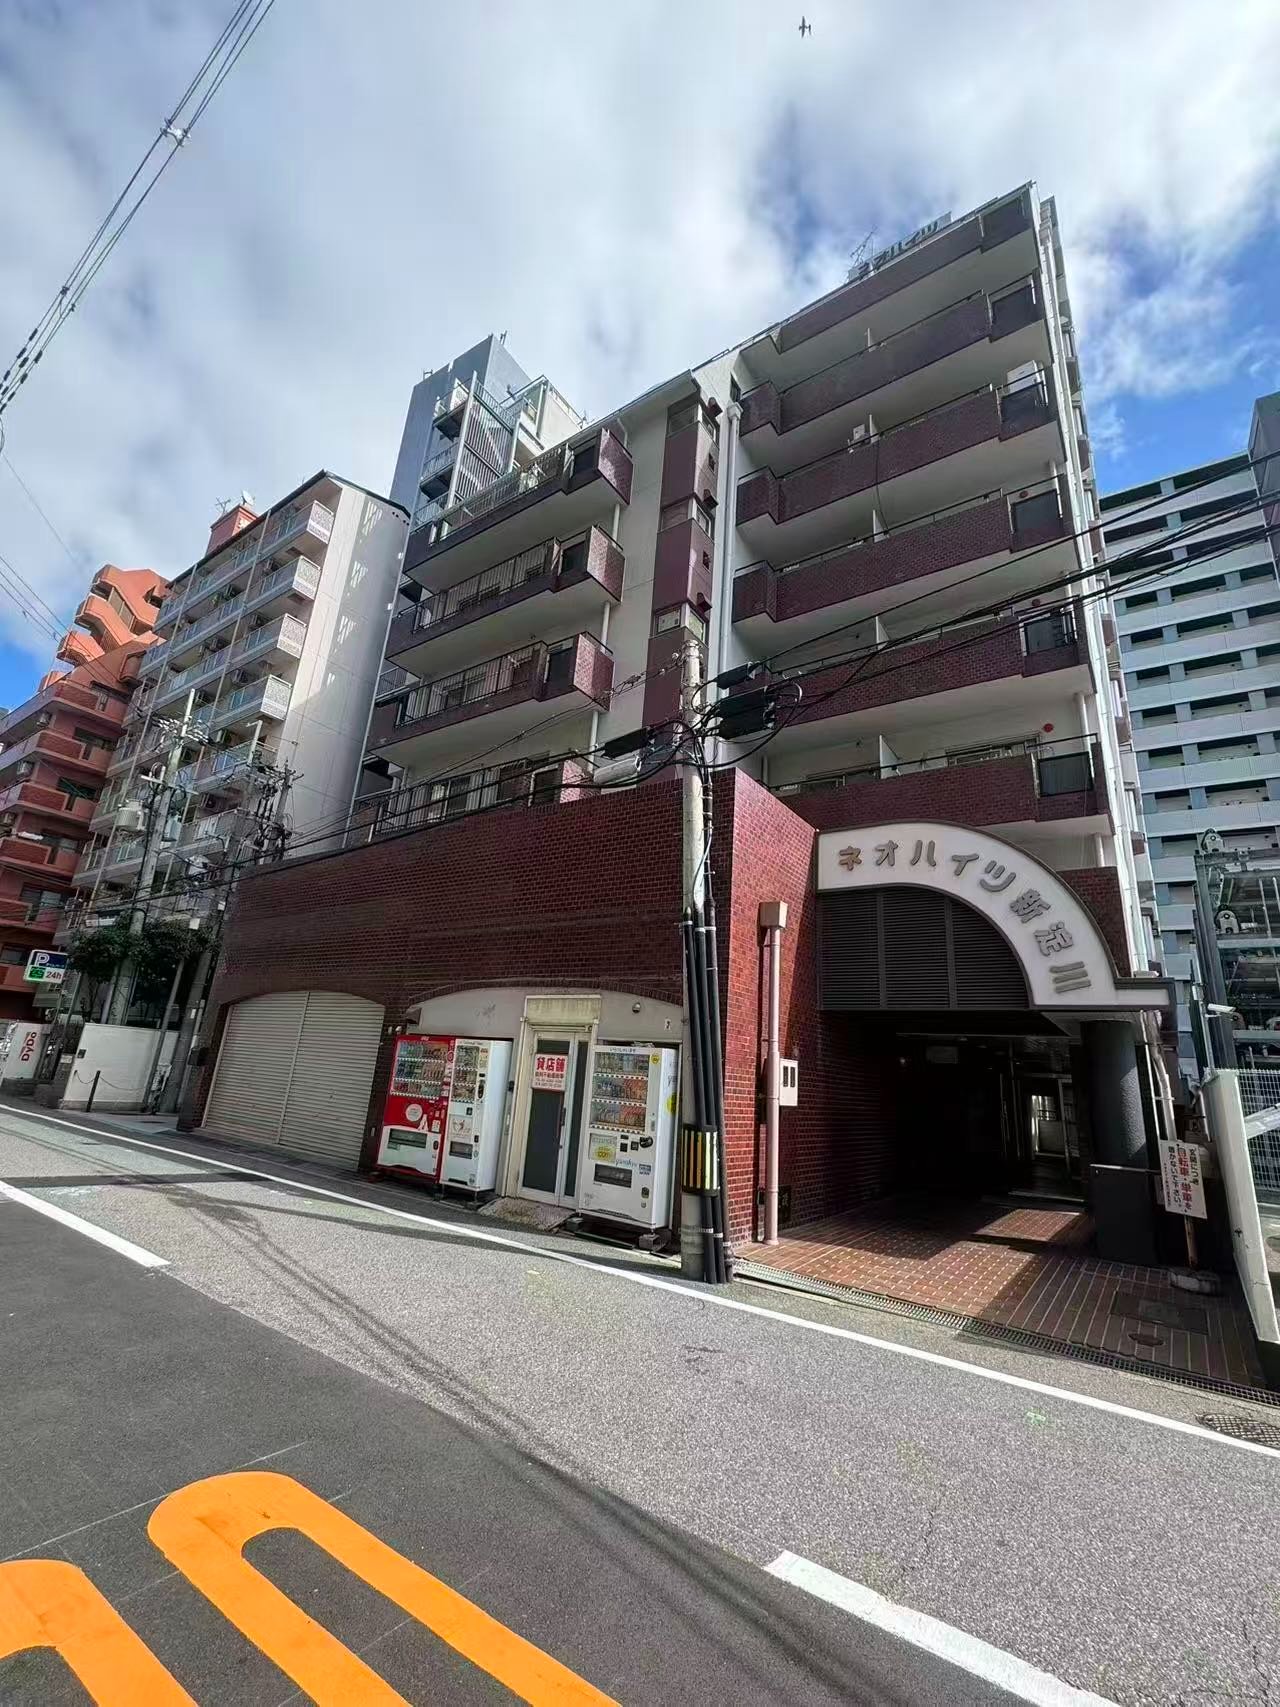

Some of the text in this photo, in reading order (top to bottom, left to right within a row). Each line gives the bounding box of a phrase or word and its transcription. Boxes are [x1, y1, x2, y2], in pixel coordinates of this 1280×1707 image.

[838, 839, 1092, 994] ネオハイツ新淀川
[21, 1031, 37, 1062] DyDo
[536, 1056, 566, 1073] 貸店舗
